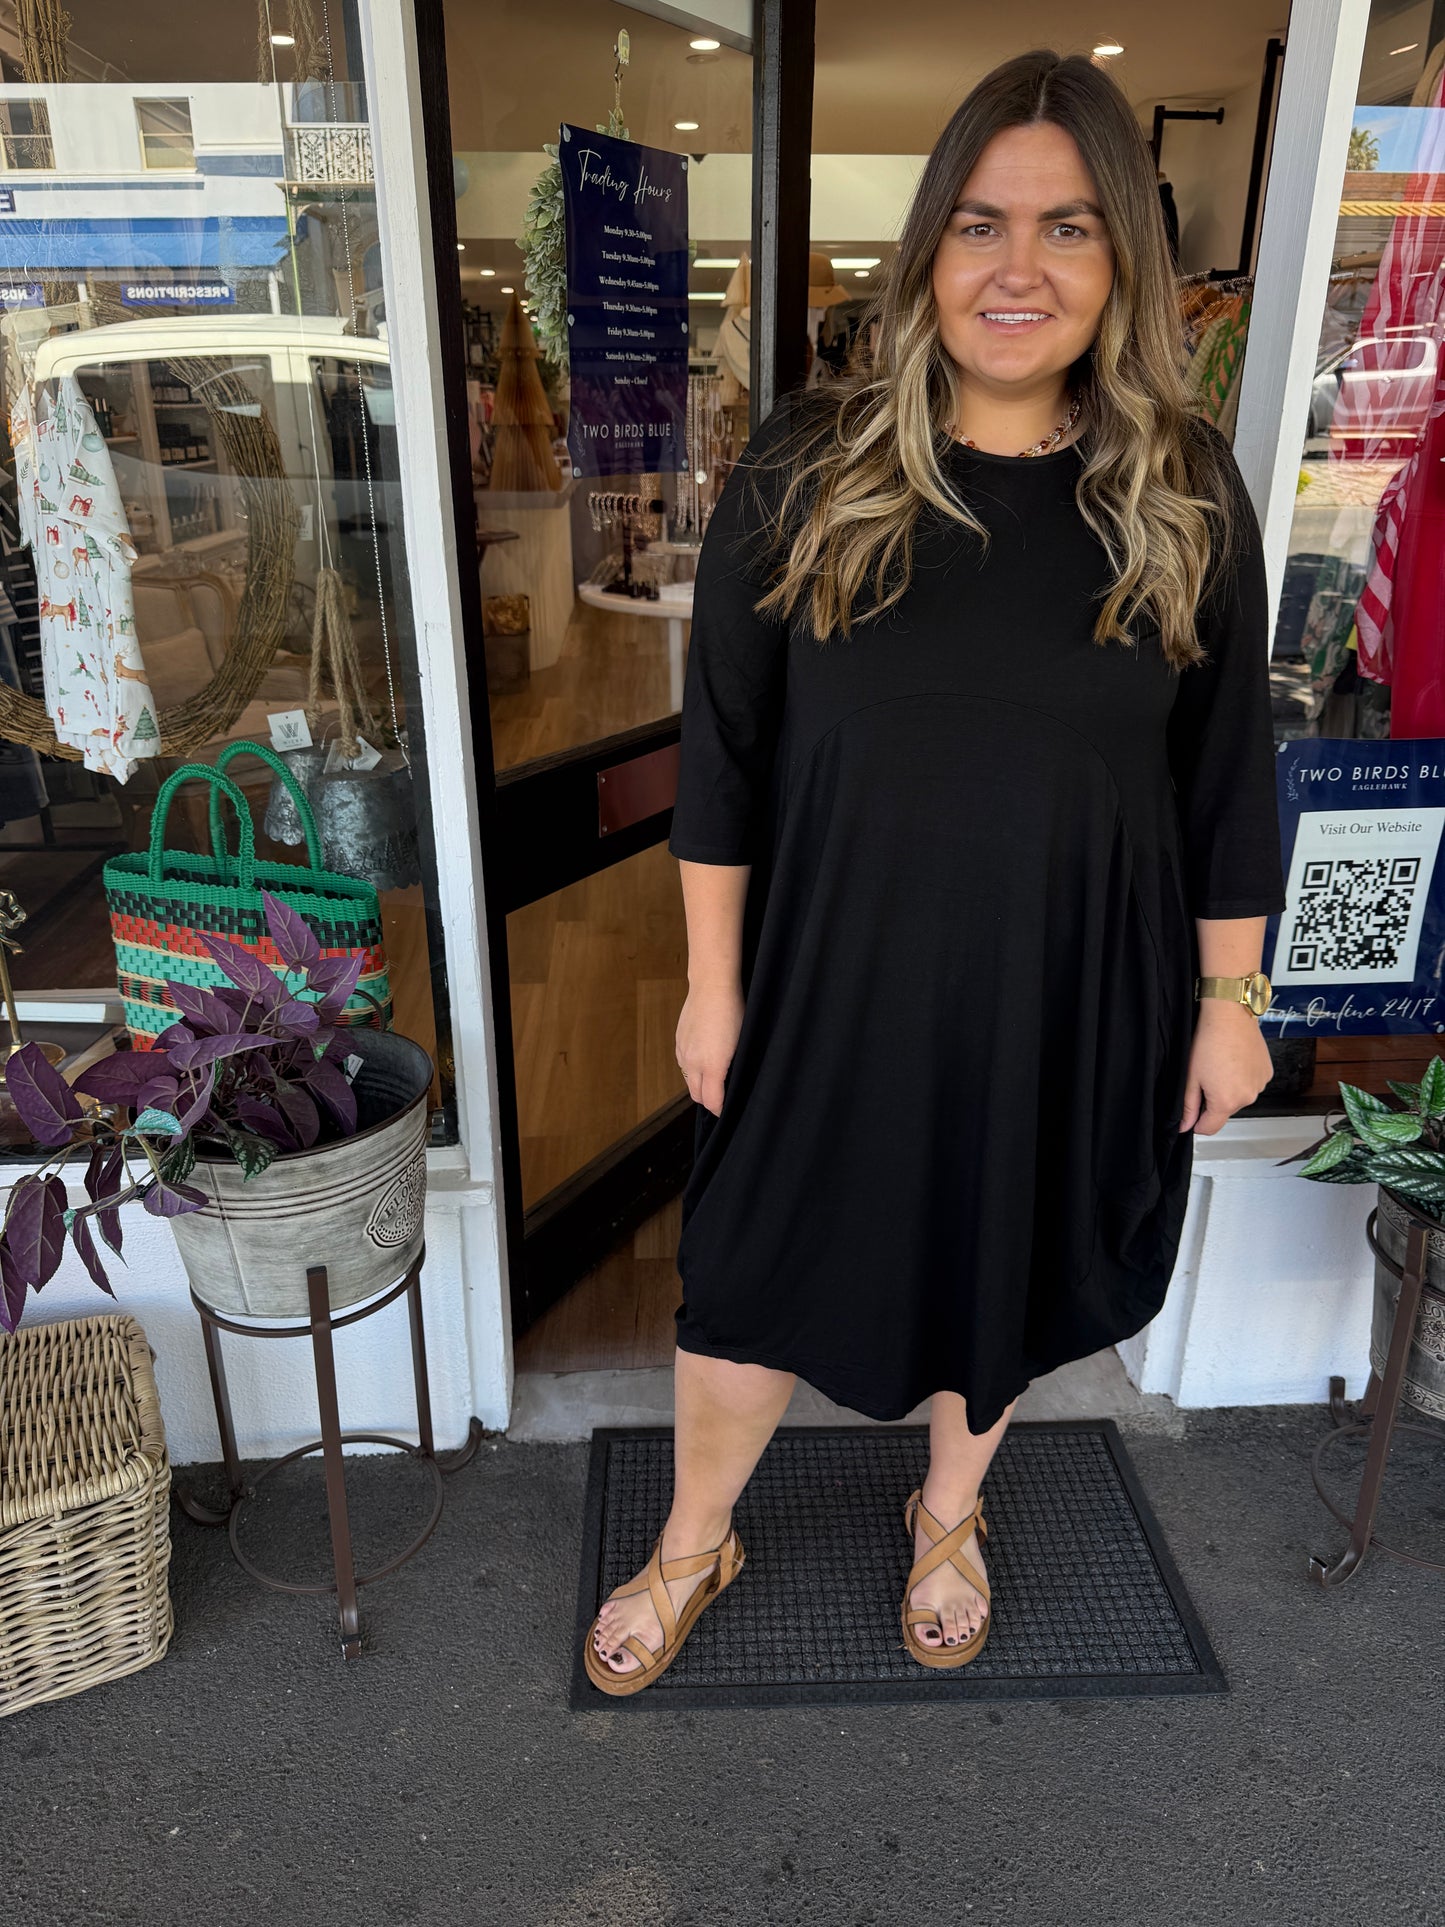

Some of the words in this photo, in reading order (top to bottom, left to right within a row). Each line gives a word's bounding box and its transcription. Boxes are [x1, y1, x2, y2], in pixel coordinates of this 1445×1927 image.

[578, 149, 629, 201] Trading
[633, 165, 672, 205] Hours
[604, 225, 623, 238] Monday
[602, 250, 621, 263] Tuesday
[599, 275, 626, 289] Wednesday
[602, 301, 624, 314] Thursday
[607, 326, 622, 338] Friday
[605, 351, 625, 363] Saturday
[614, 376, 630, 387] Sunday
[634, 376, 648, 385] Closed
[583, 424, 609, 439] TWO
[614, 424, 644, 438] BIRDS
[648, 423, 671, 437] BLUE
[1300, 767, 1342, 783] TWO
[1352, 765, 1410, 780] BIRDS
[1352, 783, 1408, 791] EAGLEHAWK
[1319, 824, 1347, 835] Visit
[1350, 823, 1373, 834] Our
[1377, 821, 1422, 833] Website
[1306, 994, 1377, 1031] Online
[1381, 997, 1436, 1019] 24/7
